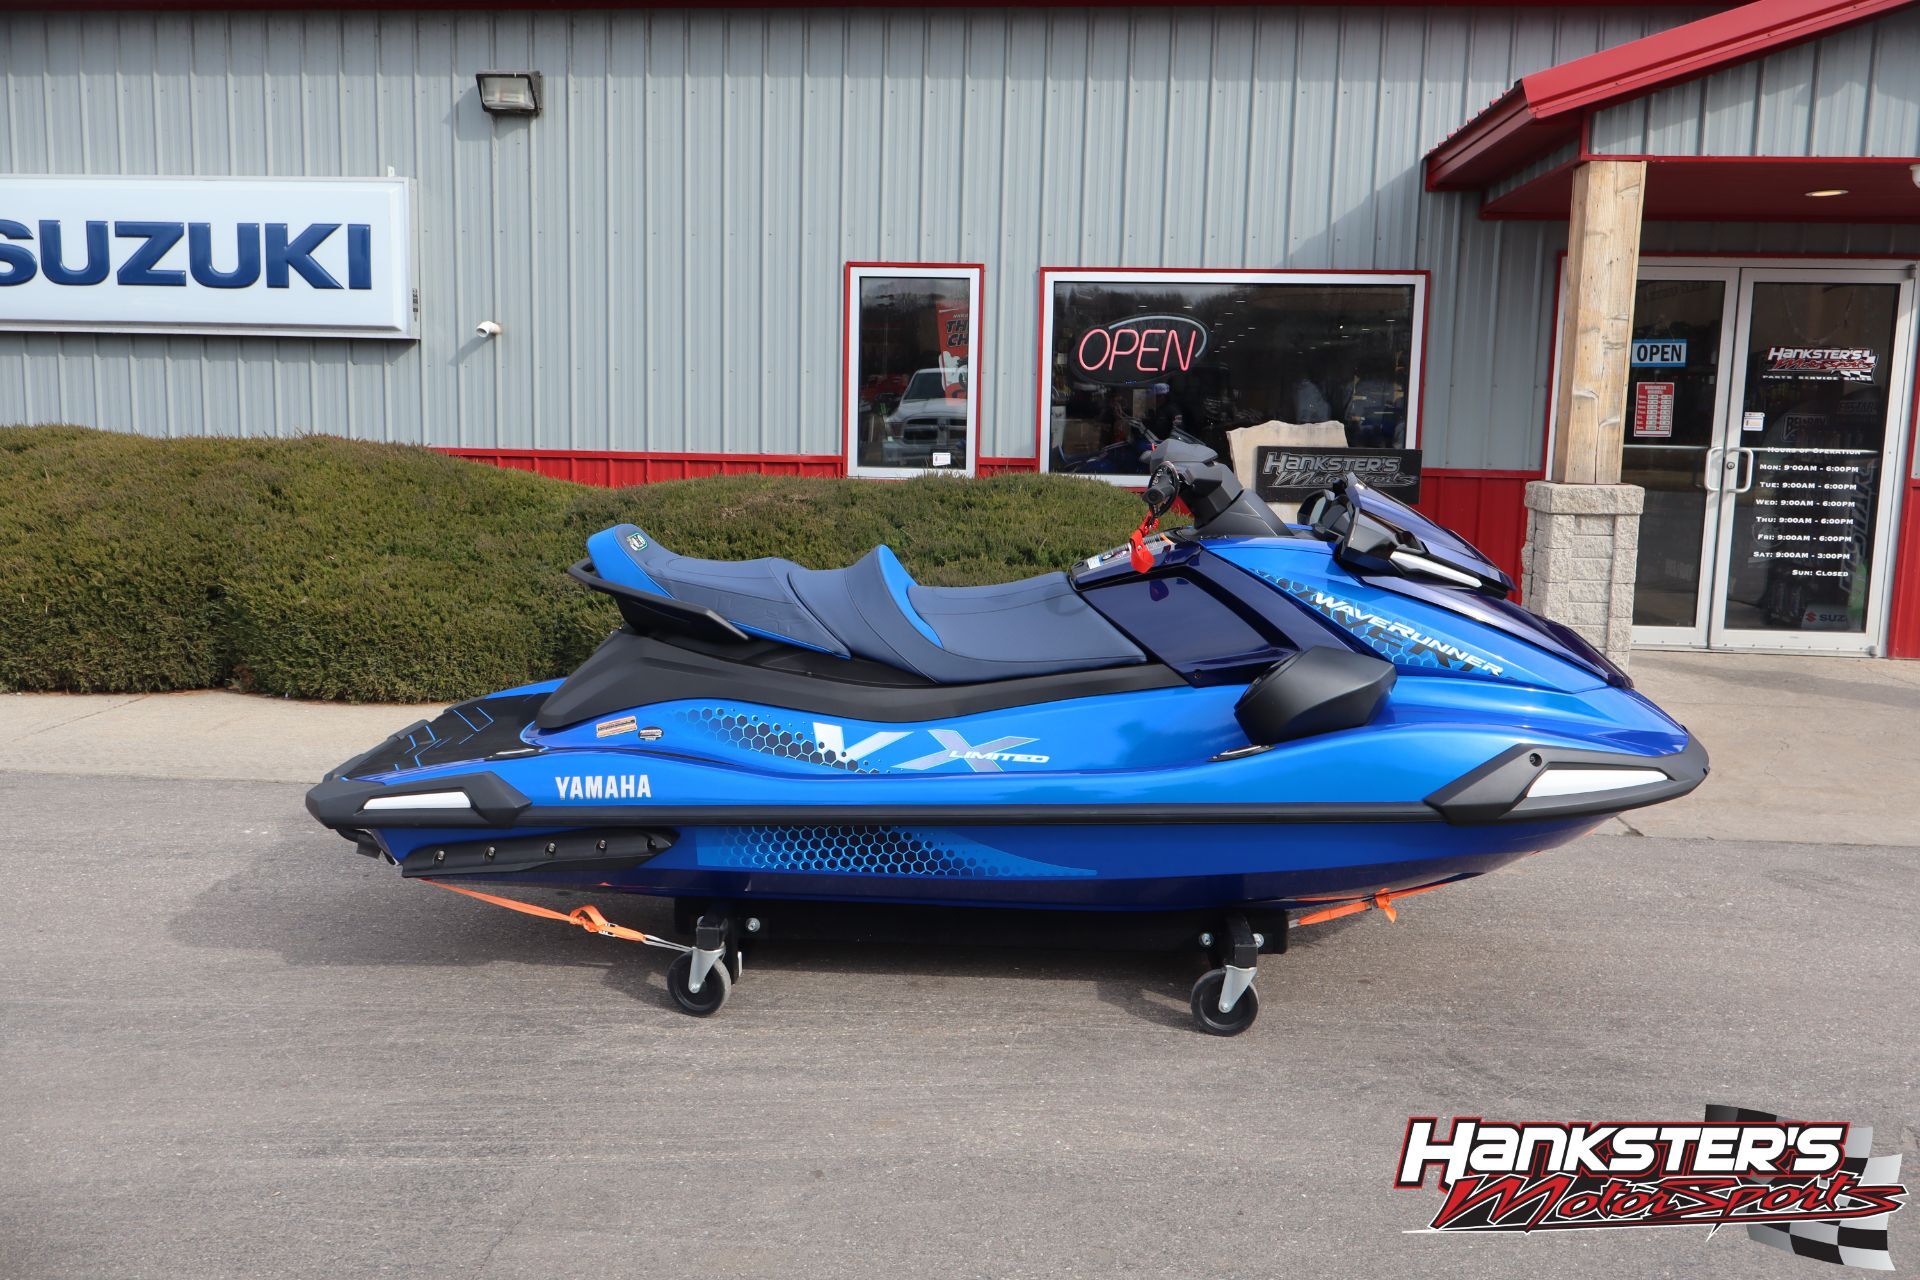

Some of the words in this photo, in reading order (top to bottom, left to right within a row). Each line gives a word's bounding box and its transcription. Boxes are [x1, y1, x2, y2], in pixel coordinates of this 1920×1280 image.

[1078, 328, 1197, 373] OPEN
[1636, 344, 1682, 362] OPEN
[1312, 592, 1504, 676] WAVERUNNER
[949, 749, 1050, 763] LIMITED
[555, 774, 652, 800] YAMAHA
